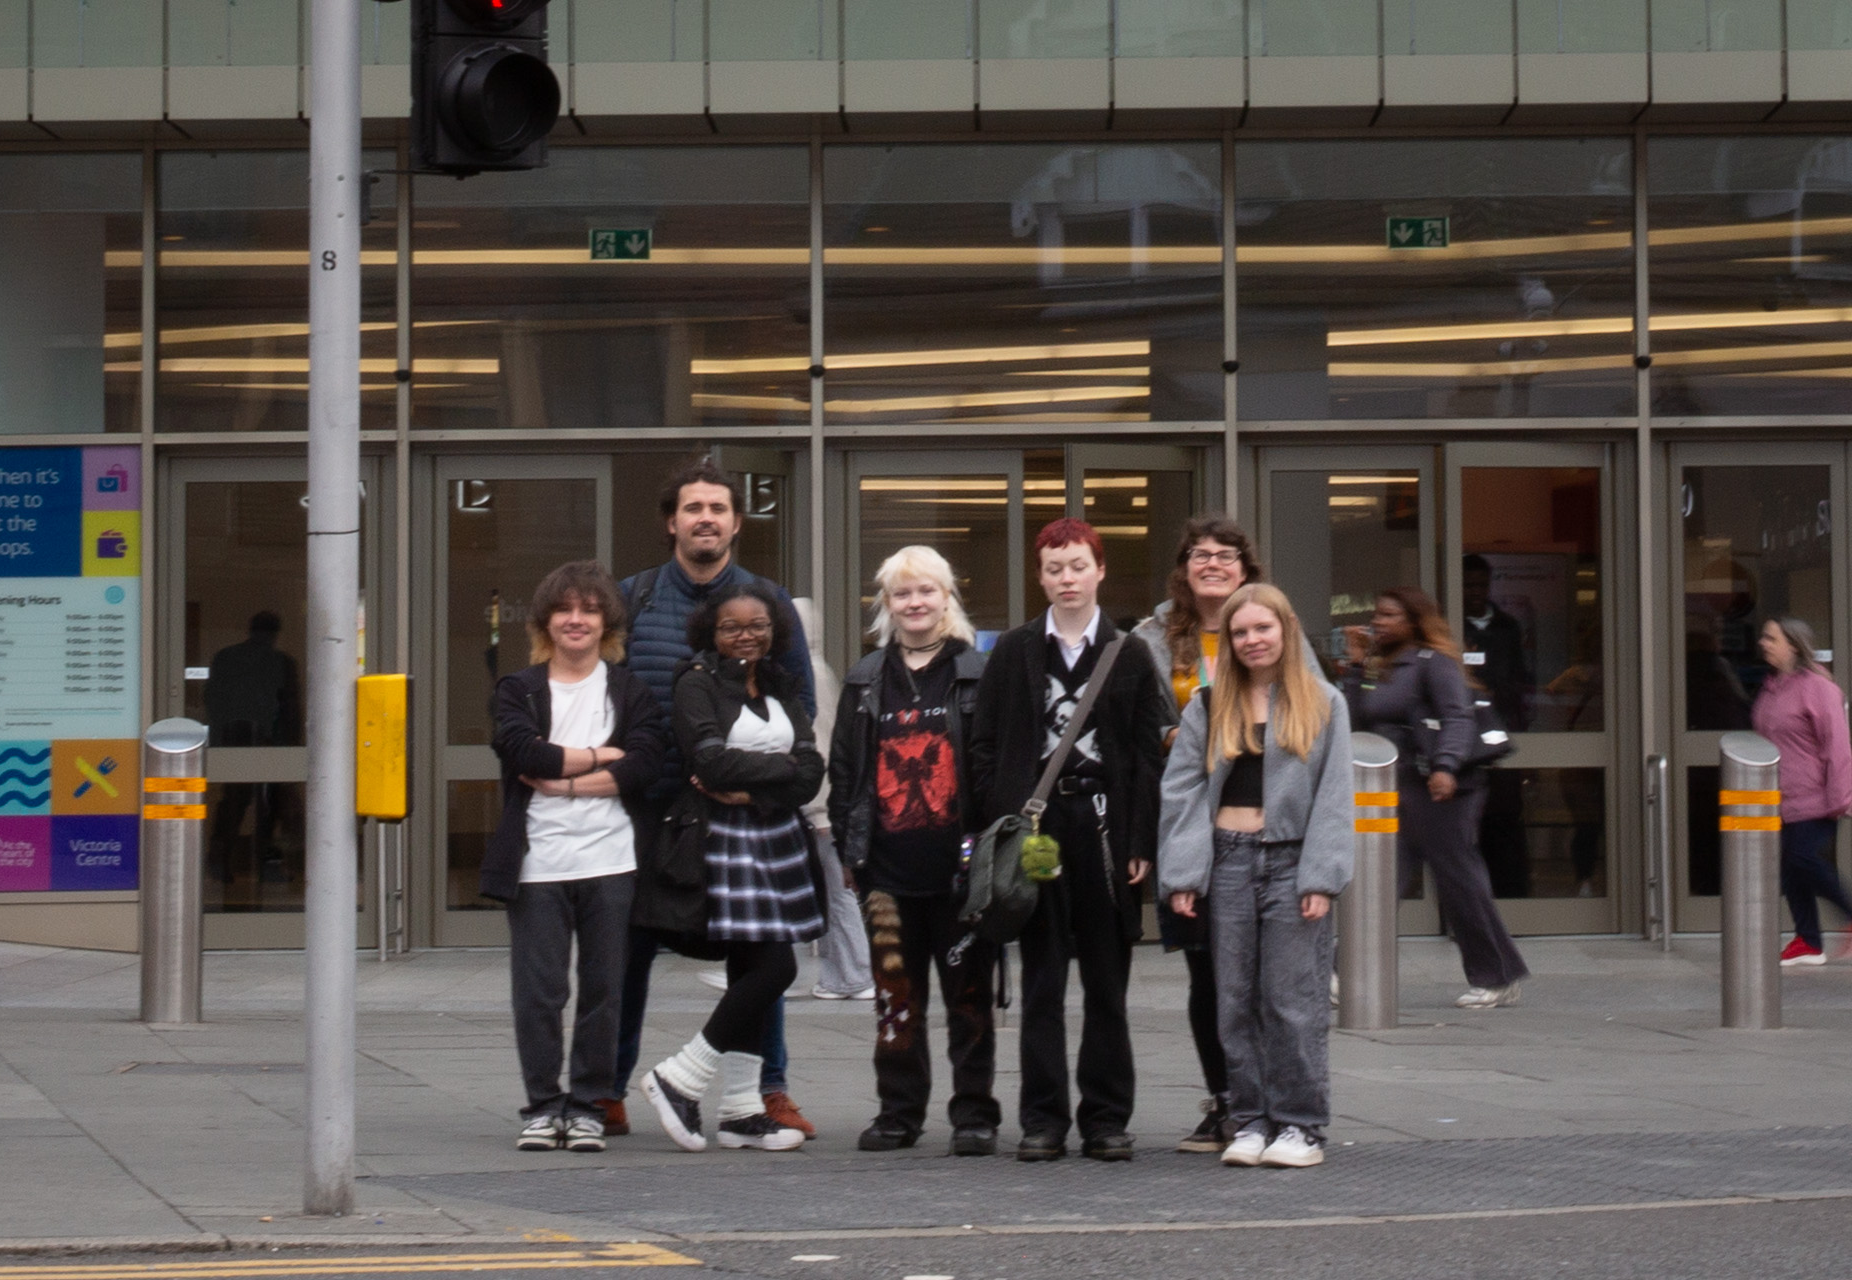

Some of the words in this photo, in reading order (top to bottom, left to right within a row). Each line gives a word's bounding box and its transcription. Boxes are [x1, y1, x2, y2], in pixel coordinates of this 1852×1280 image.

[36, 468, 60, 485] it's
[23, 494, 43, 508] to
[7, 514, 37, 532] the
[28, 595, 62, 605] Hours
[69, 839, 122, 852] Victoria
[76, 853, 122, 866] Centre
